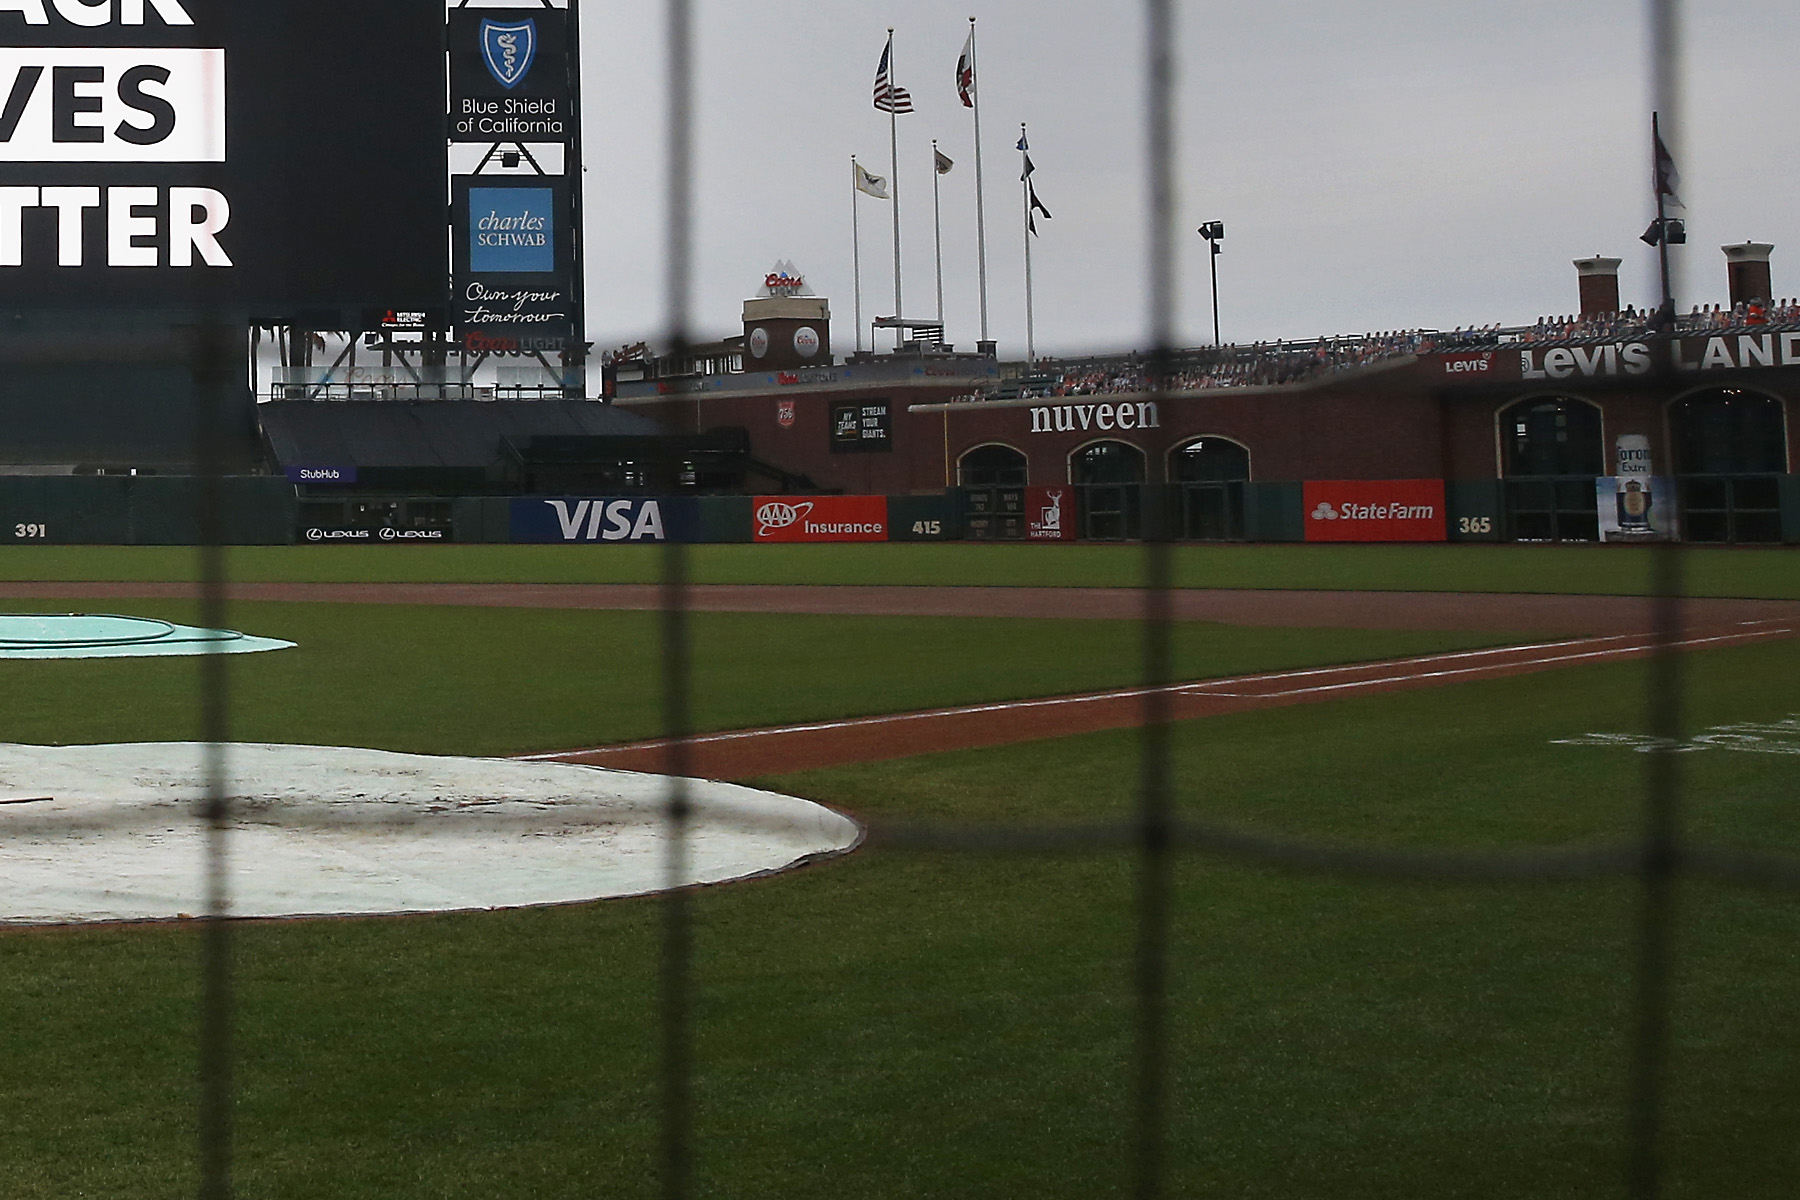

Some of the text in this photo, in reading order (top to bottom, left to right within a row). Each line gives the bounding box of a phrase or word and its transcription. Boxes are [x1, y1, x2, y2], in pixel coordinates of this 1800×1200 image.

[462, 99, 556, 114] Blue Shield
[457, 117, 563, 133] of California
[478, 210, 546, 231] charles
[477, 233, 546, 246] SCHWAB
[466, 282, 561, 311] Own your
[464, 306, 565, 324] tomorrow
[862, 406, 886, 416] STREAM
[1029, 400, 1161, 433] nuveen
[862, 417, 878, 427] YOUR
[300, 469, 340, 479] StubHub
[761, 503, 792, 521] AAA
[544, 500, 665, 540] VISA
[804, 520, 882, 534] Insurance
[1459, 517, 1491, 533] 365
[15, 523, 45, 537] 391
[323, 530, 369, 538] LEXUS
[396, 530, 442, 538] LEXUS
[912, 521, 941, 534] 415
[1030, 530, 1061, 538] HARTFORD
